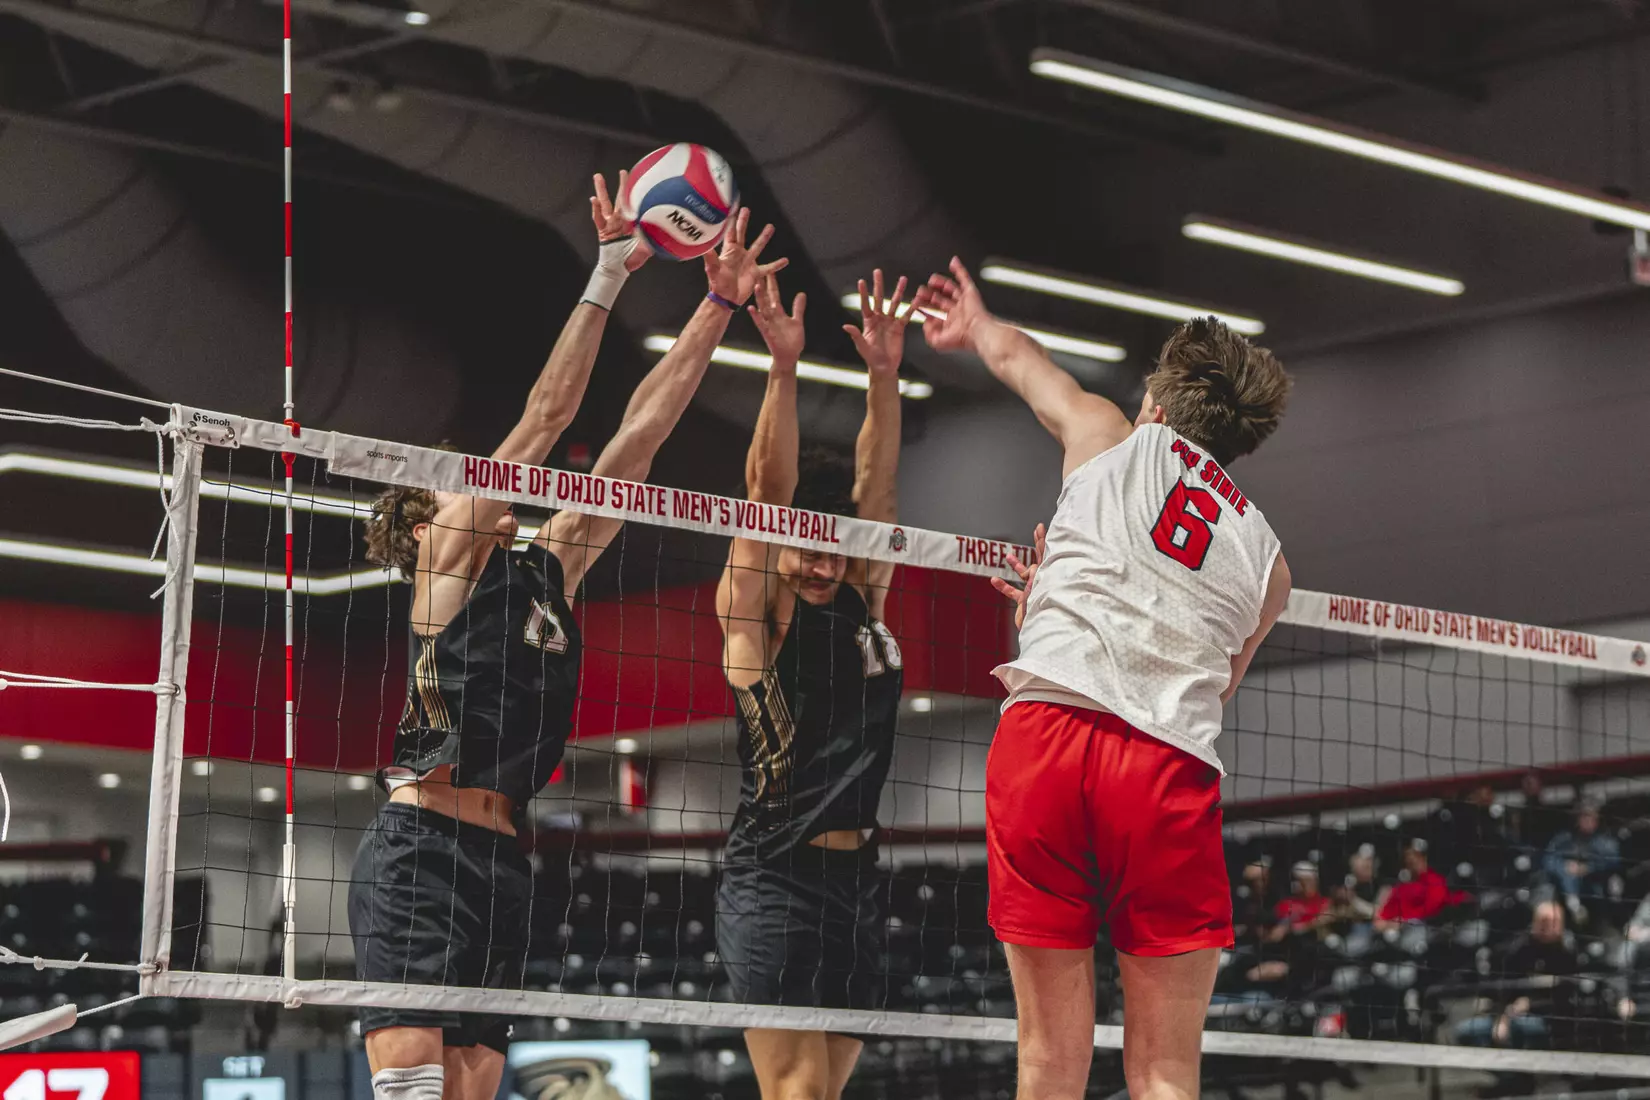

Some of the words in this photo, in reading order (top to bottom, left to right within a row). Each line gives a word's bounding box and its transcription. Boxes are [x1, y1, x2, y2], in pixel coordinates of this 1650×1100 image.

[666, 210, 704, 241] NCAA
[202, 415, 230, 427] Senoh
[464, 456, 521, 493] HOME
[528, 466, 552, 496] OF
[557, 472, 606, 506] OHIO
[611, 481, 666, 516] STATE
[673, 490, 730, 526] MEN'S
[735, 501, 839, 543] VOLLEYBALL
[1149, 476, 1222, 571] 6
[955, 535, 1006, 568] THREE
[1329, 596, 1369, 626] HOME
[1373, 602, 1391, 628] OF
[1395, 605, 1430, 633] OHIO
[1434, 611, 1473, 639] STATE
[1477, 618, 1518, 647] MEN'S
[1522, 626, 1597, 660] VOLLEYBALL
